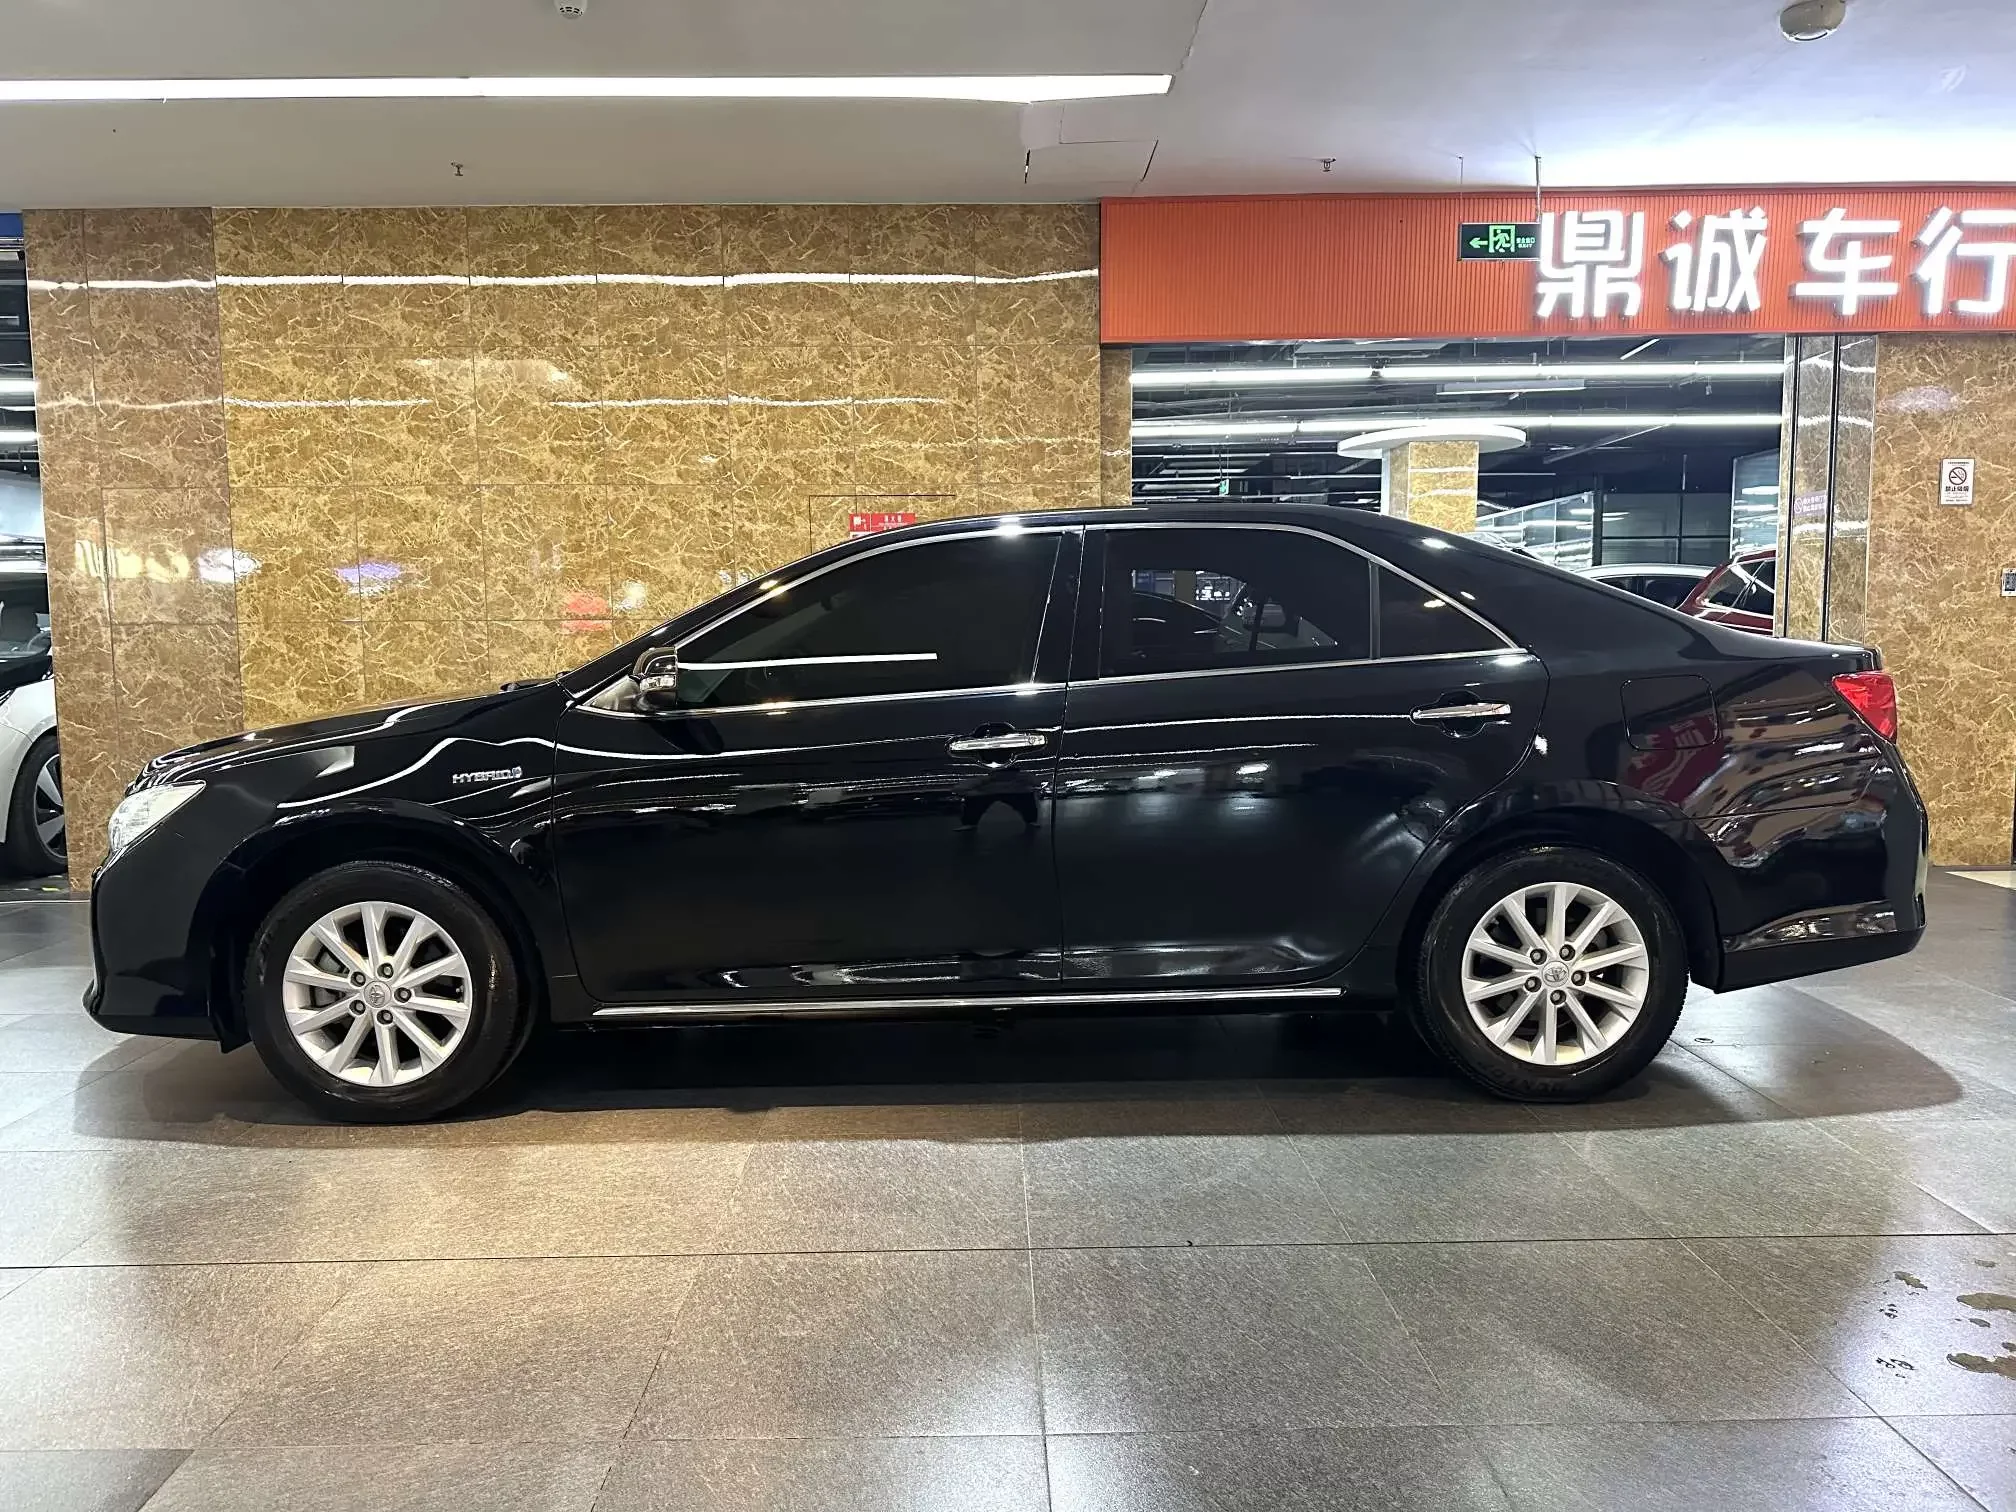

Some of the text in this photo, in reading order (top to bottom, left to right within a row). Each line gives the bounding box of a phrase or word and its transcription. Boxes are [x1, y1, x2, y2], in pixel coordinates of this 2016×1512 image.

[1536, 205, 2016, 318] 鼎诚车行
[452, 769, 511, 784] HYBRID
